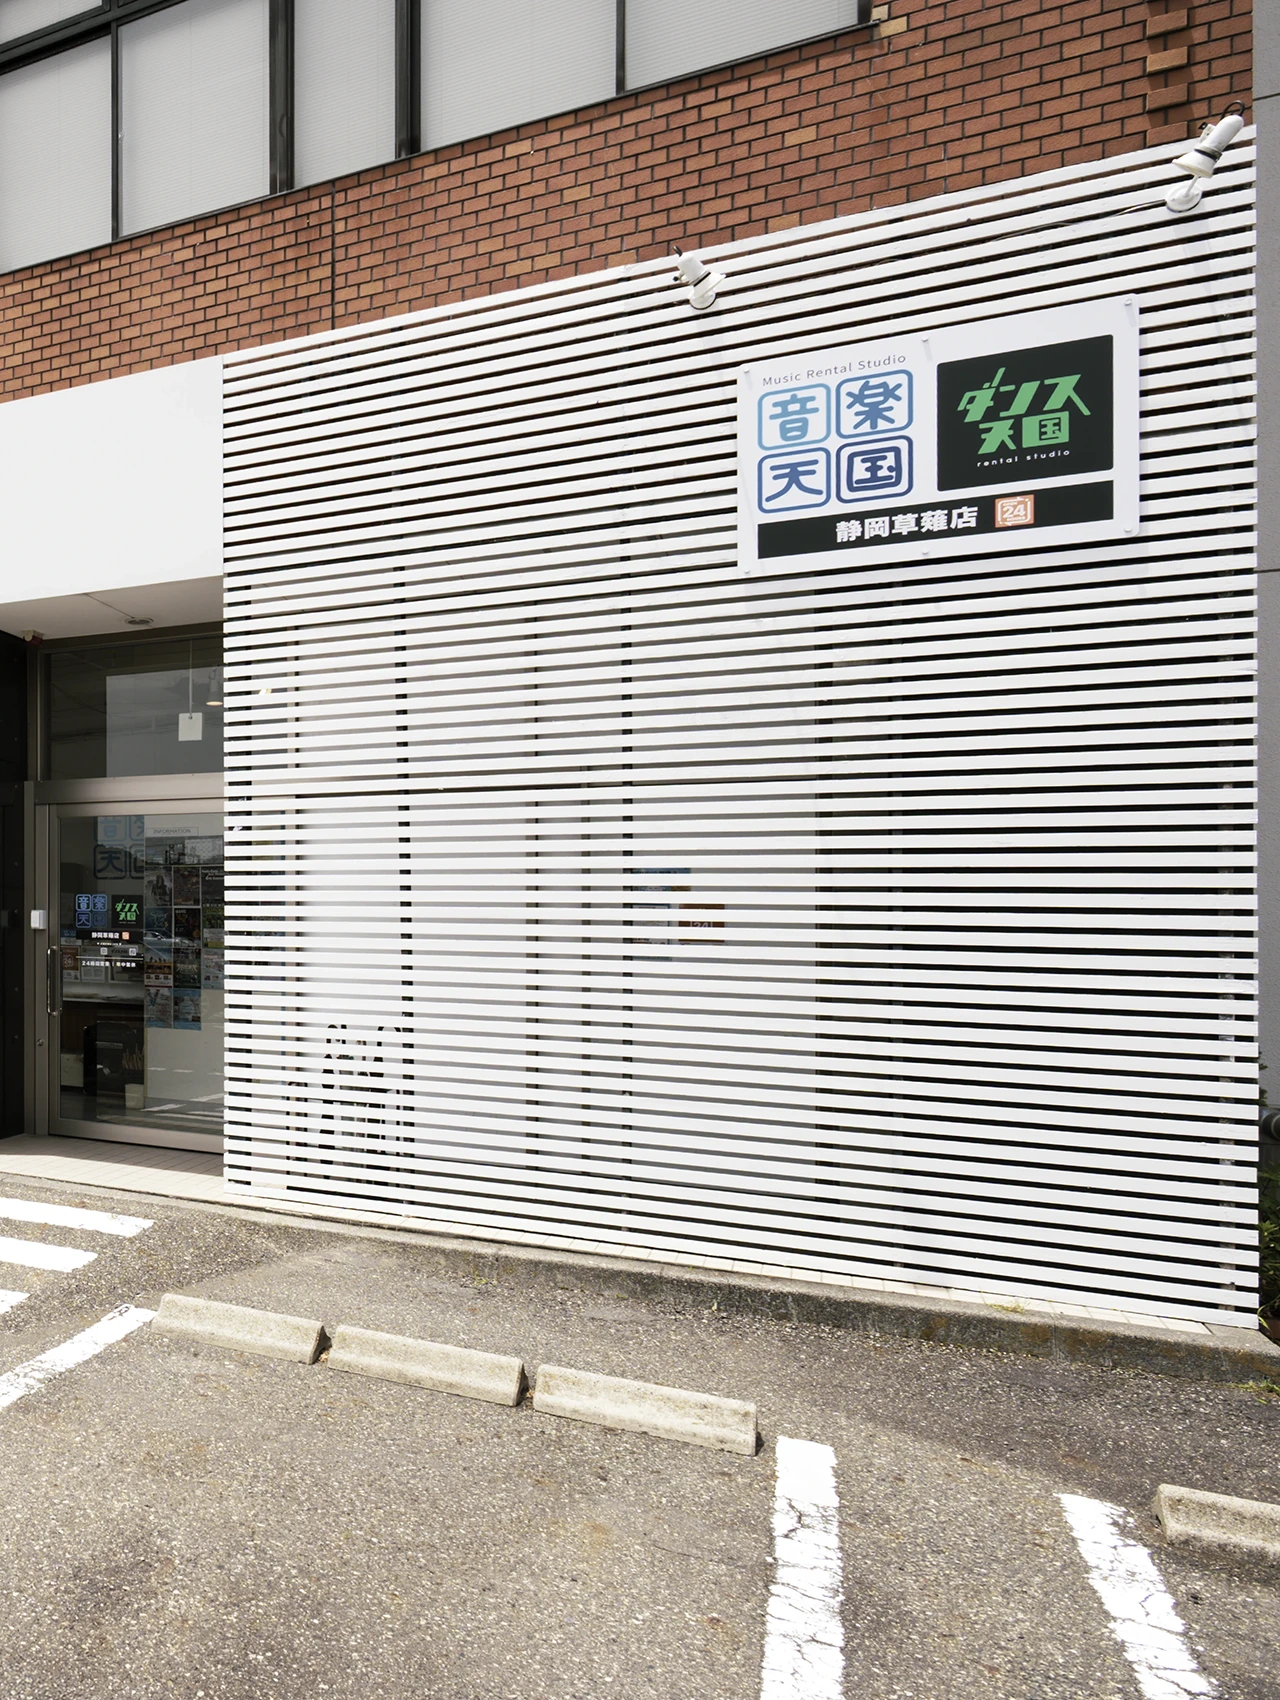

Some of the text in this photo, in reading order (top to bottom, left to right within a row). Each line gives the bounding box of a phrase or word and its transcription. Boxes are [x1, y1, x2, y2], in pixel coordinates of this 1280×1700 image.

[762, 354, 906, 387] Music Rental Studio
[769, 380, 902, 442] 音楽
[957, 367, 1091, 422] ダンス
[978, 411, 1069, 454] 天国
[765, 446, 902, 502] 天国
[977, 450, 1070, 467] rental studio
[835, 506, 978, 543] 静岡草薙店
[1003, 504, 1026, 519] 24
